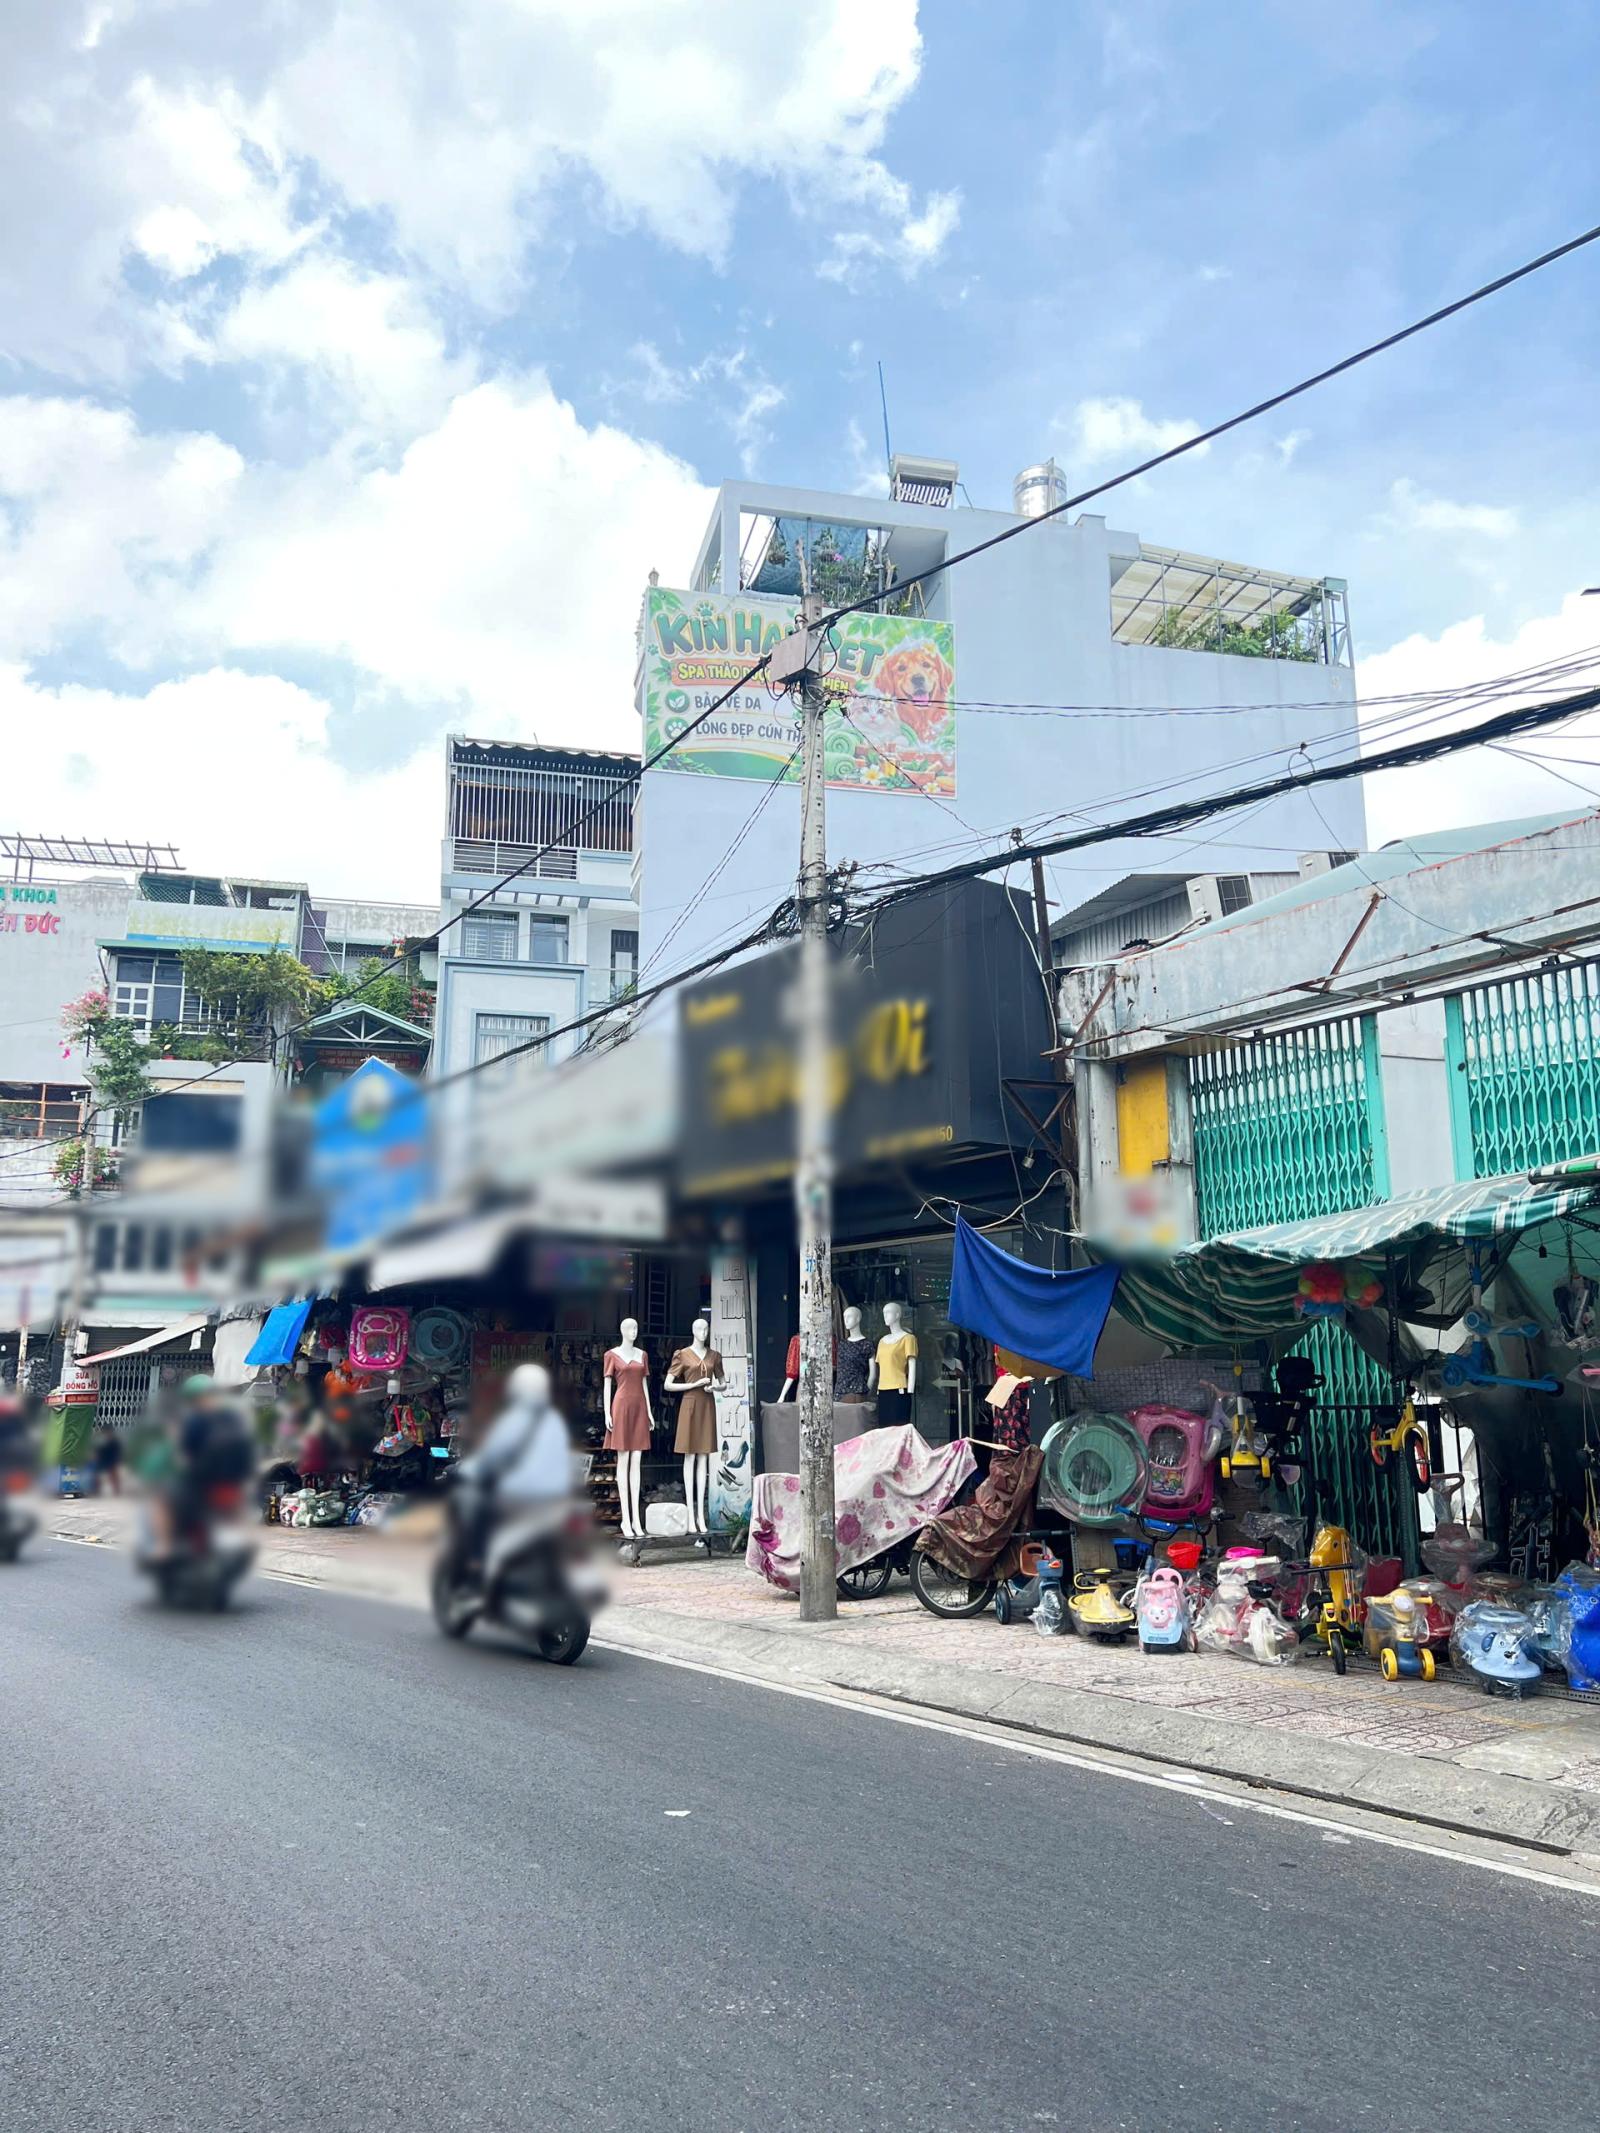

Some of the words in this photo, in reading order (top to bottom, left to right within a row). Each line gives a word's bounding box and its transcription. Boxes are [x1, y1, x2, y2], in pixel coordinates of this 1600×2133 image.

[655, 612, 729, 656] KIN
[678, 662, 706, 680] SPA
[706, 660, 740, 681] THẢO
[694, 690, 721, 709] BẢO
[725, 692, 741, 712] VỆ
[745, 696, 762, 710] DA
[730, 721, 754, 738] ĐẸP
[757, 722, 783, 739] CÚN
[12, 887, 57, 904] KHOA
